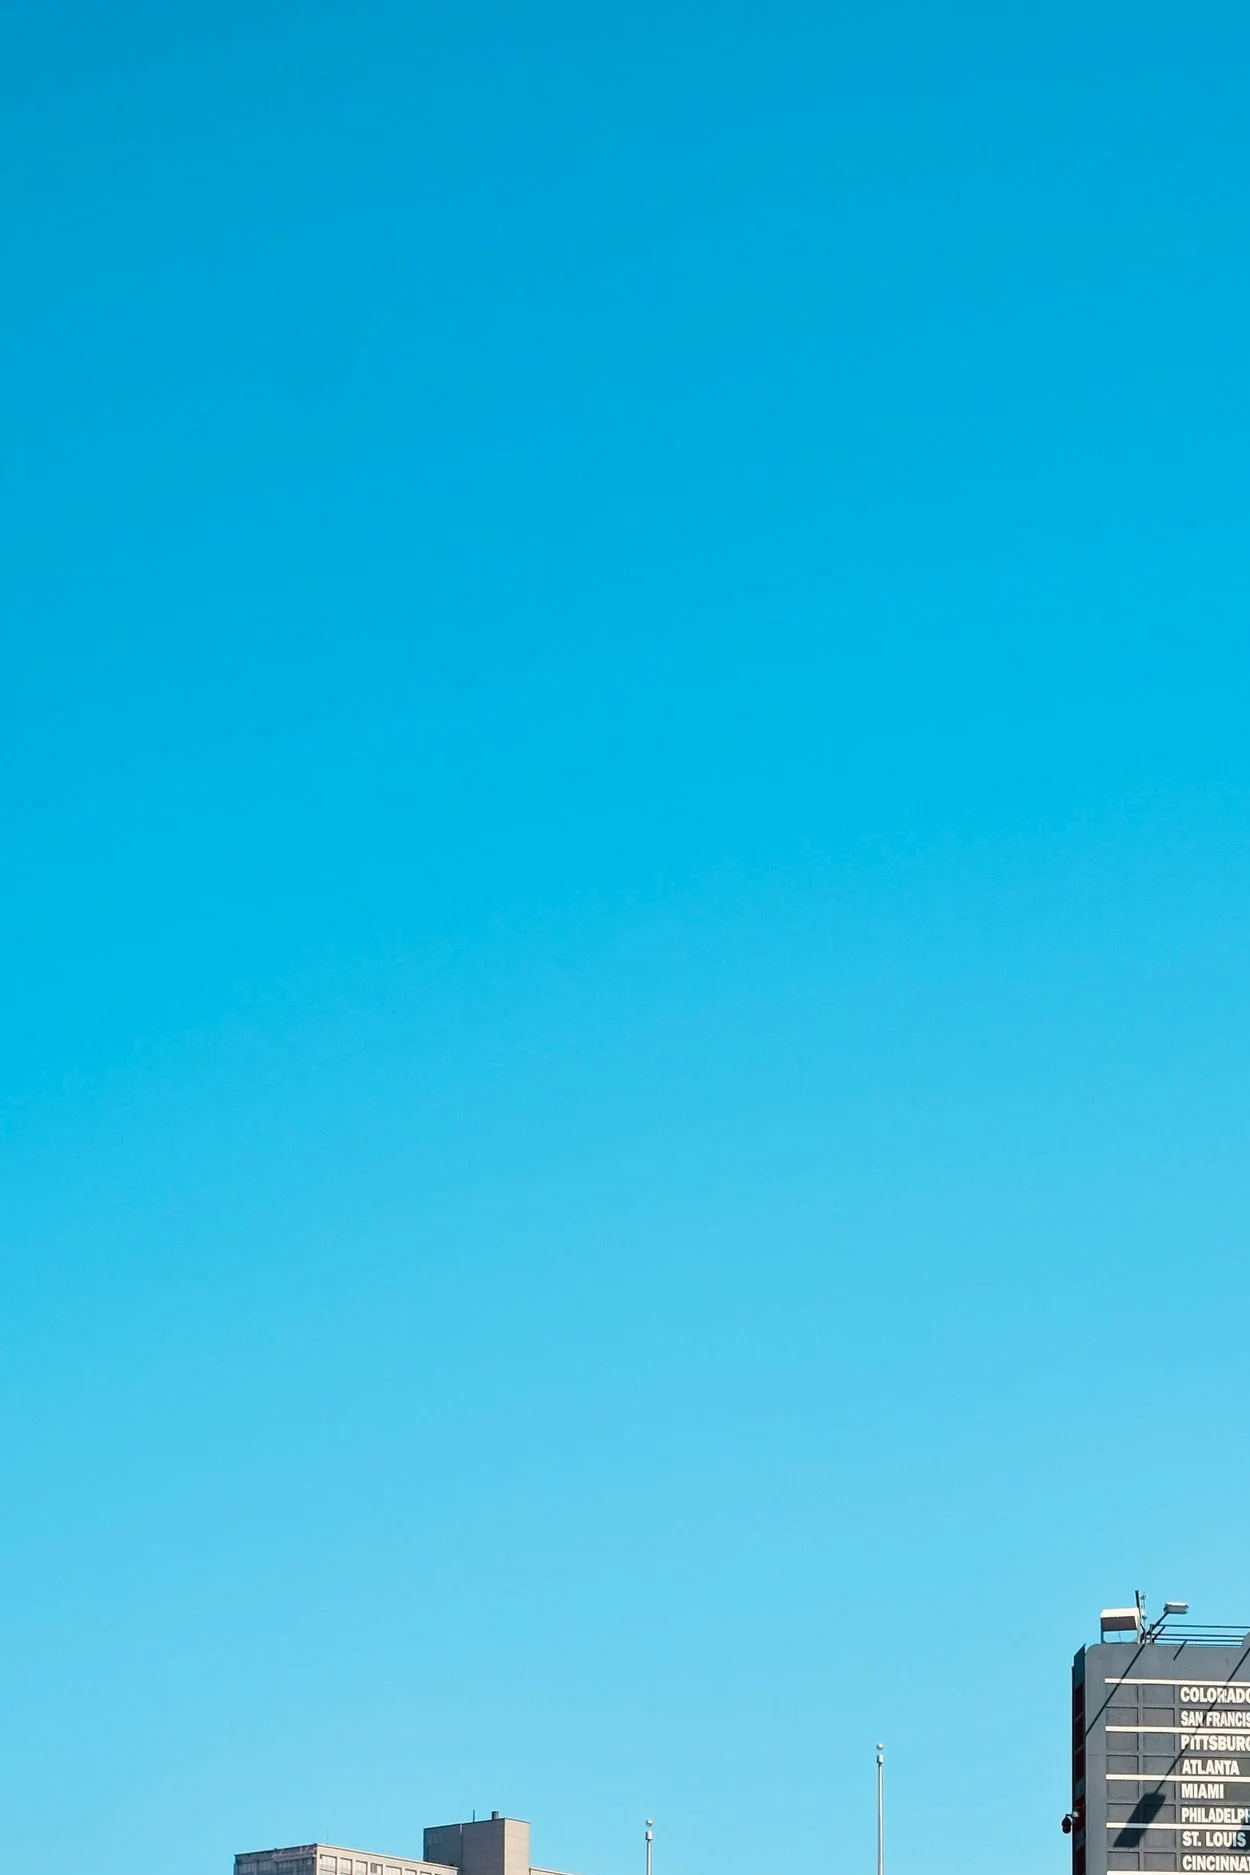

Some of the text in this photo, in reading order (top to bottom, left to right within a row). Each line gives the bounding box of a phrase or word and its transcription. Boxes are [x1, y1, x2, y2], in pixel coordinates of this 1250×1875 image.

[1181, 1711, 1203, 1726] SAN
[1182, 1760, 1239, 1775] ATLANTA
[1182, 1784, 1223, 1798] MIAMI
[1183, 1831, 1245, 1847] ST. LOUIS
